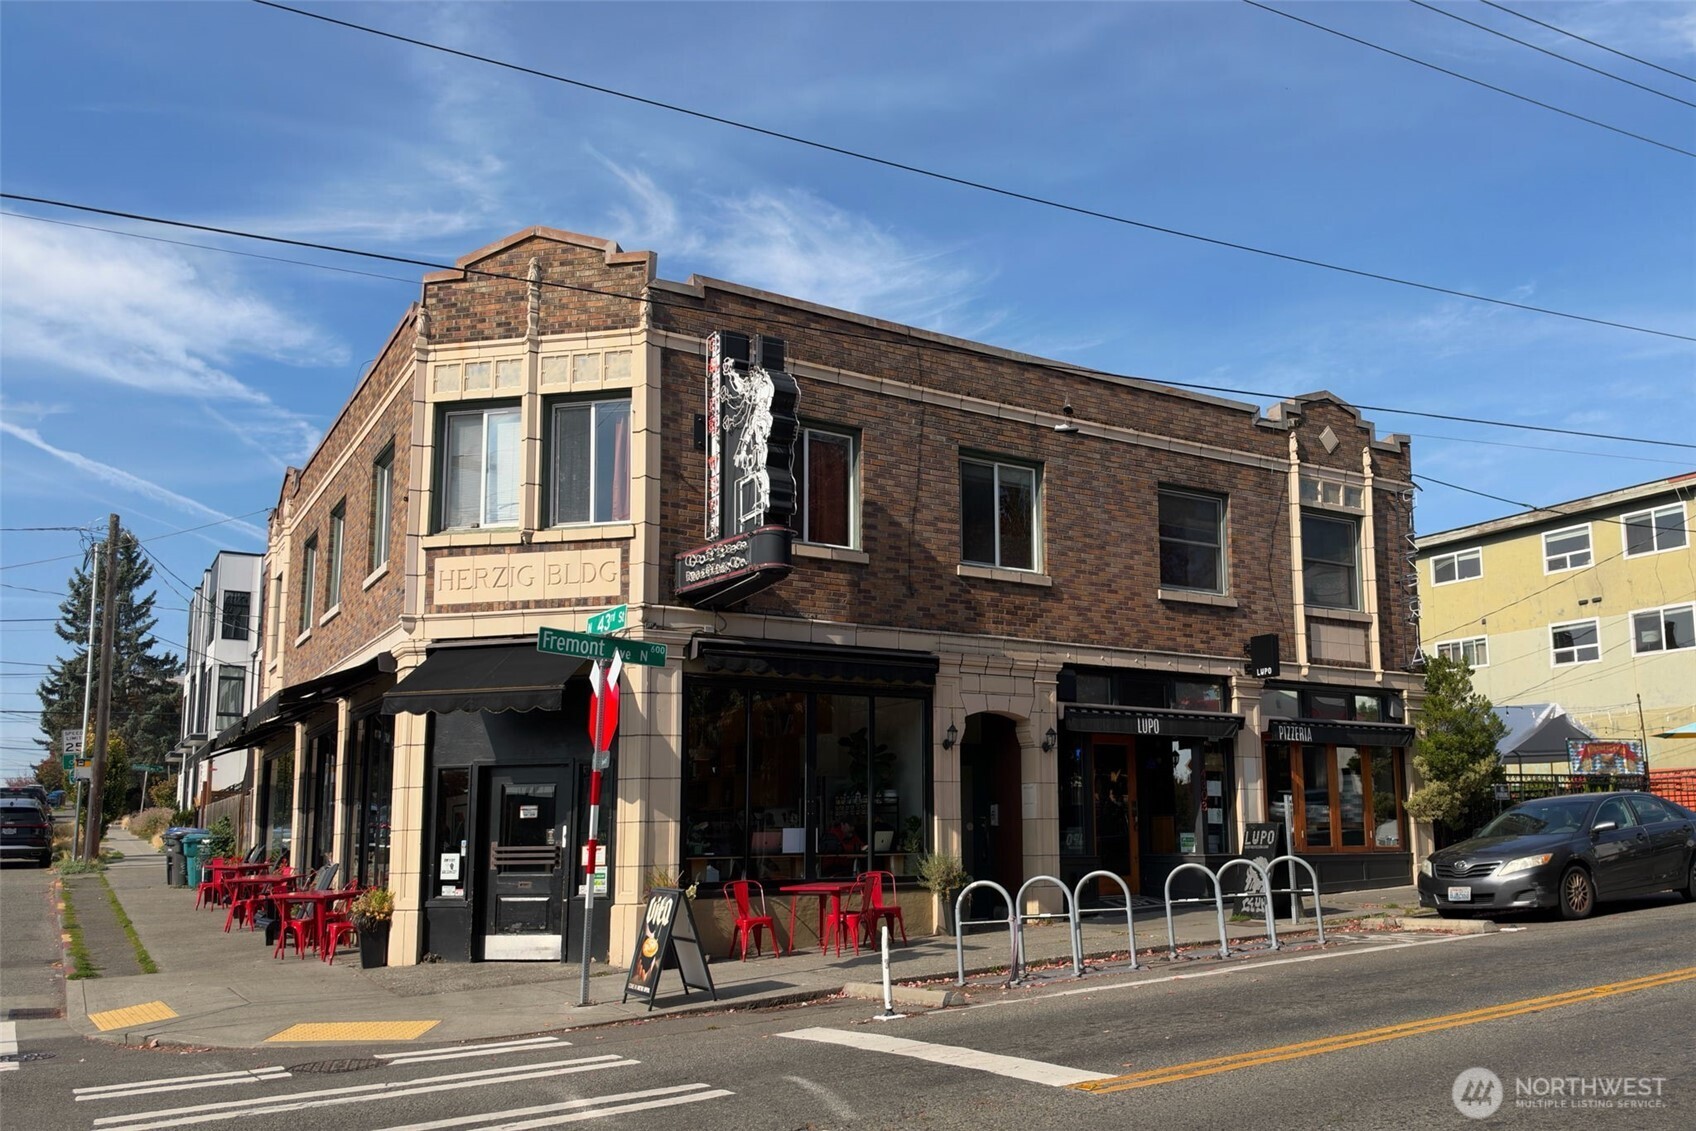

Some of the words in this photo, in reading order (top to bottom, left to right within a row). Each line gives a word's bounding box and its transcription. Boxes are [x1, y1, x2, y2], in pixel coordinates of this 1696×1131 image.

[438, 565, 535, 592] HERZIG
[546, 560, 617, 586] BLDG
[597, 613, 616, 632] 43rd
[618, 611, 625, 623] St
[542, 630, 605, 657] Fremont
[612, 646, 631, 660] Ave
[640, 650, 648, 662] N
[650, 645, 665, 655] 600
[1256, 666, 1272, 677] LUPO
[1137, 717, 1160, 735] LUPO
[1278, 725, 1312, 742] PIZZERIA
[65, 742, 83, 752] 25
[1244, 830, 1275, 845] LUPO
